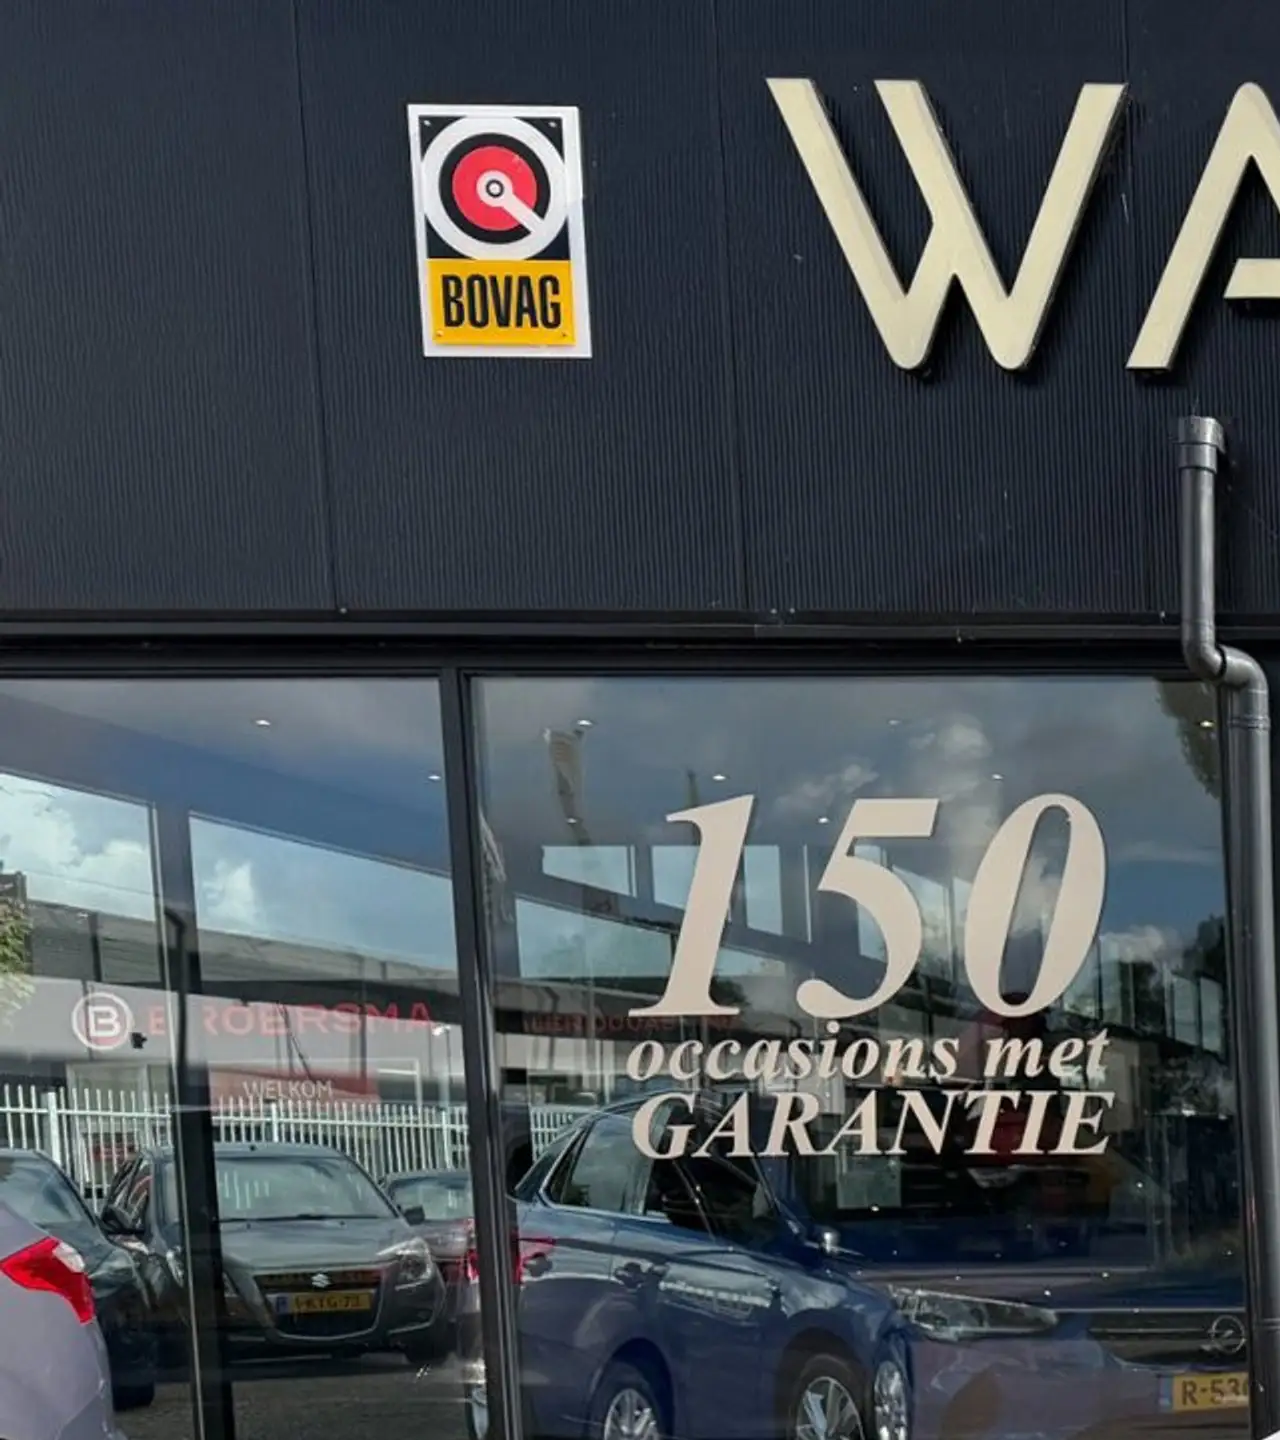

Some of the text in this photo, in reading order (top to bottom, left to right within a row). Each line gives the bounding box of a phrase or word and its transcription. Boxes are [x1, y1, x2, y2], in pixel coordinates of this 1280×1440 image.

[442, 274, 561, 329] BOVAG
[628, 792, 1108, 1018] 150
[625, 1020, 1111, 1084] occasions met
[242, 1080, 333, 1101] WELKOM
[632, 1090, 1115, 1160] GARANTIE
